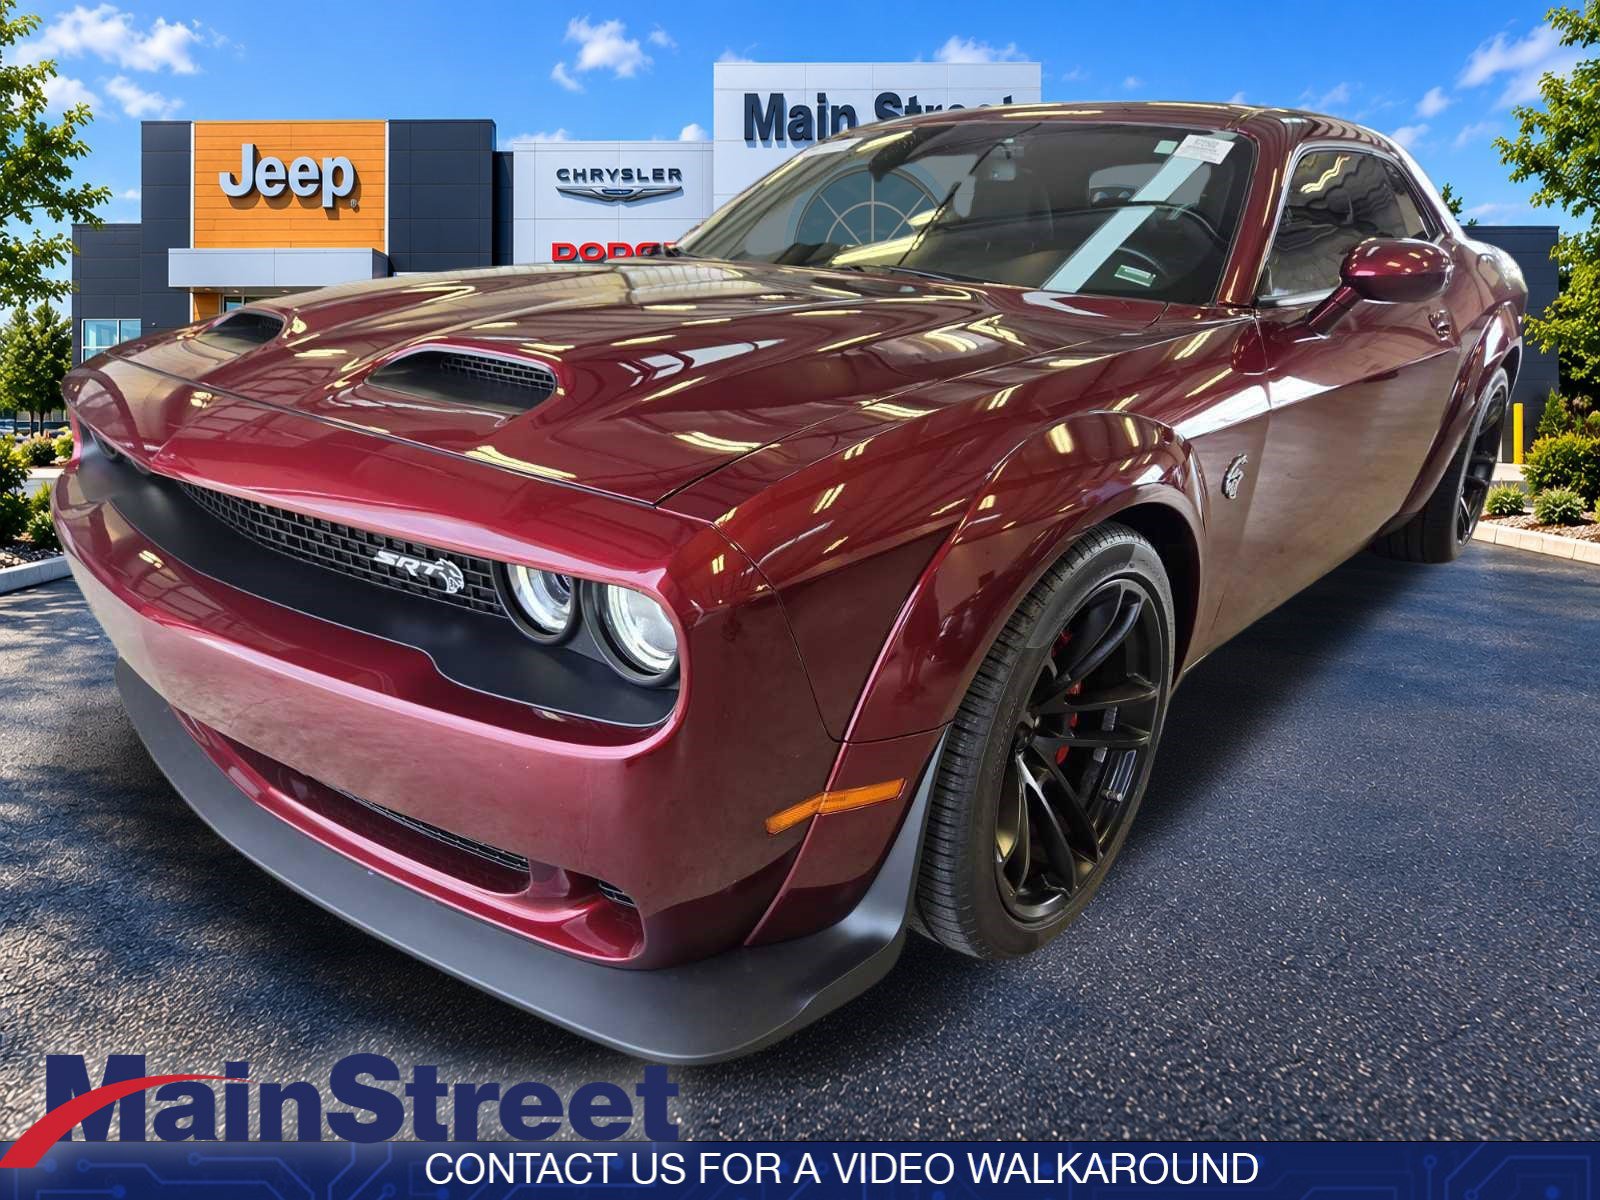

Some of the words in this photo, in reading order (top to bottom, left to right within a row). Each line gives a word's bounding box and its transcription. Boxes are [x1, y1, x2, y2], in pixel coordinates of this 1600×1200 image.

[744, 92, 857, 141] Main
[218, 143, 355, 209] Jeep
[556, 168, 682, 182] CHRYSLER
[551, 241, 677, 262] DODG
[373, 550, 444, 577] SRT
